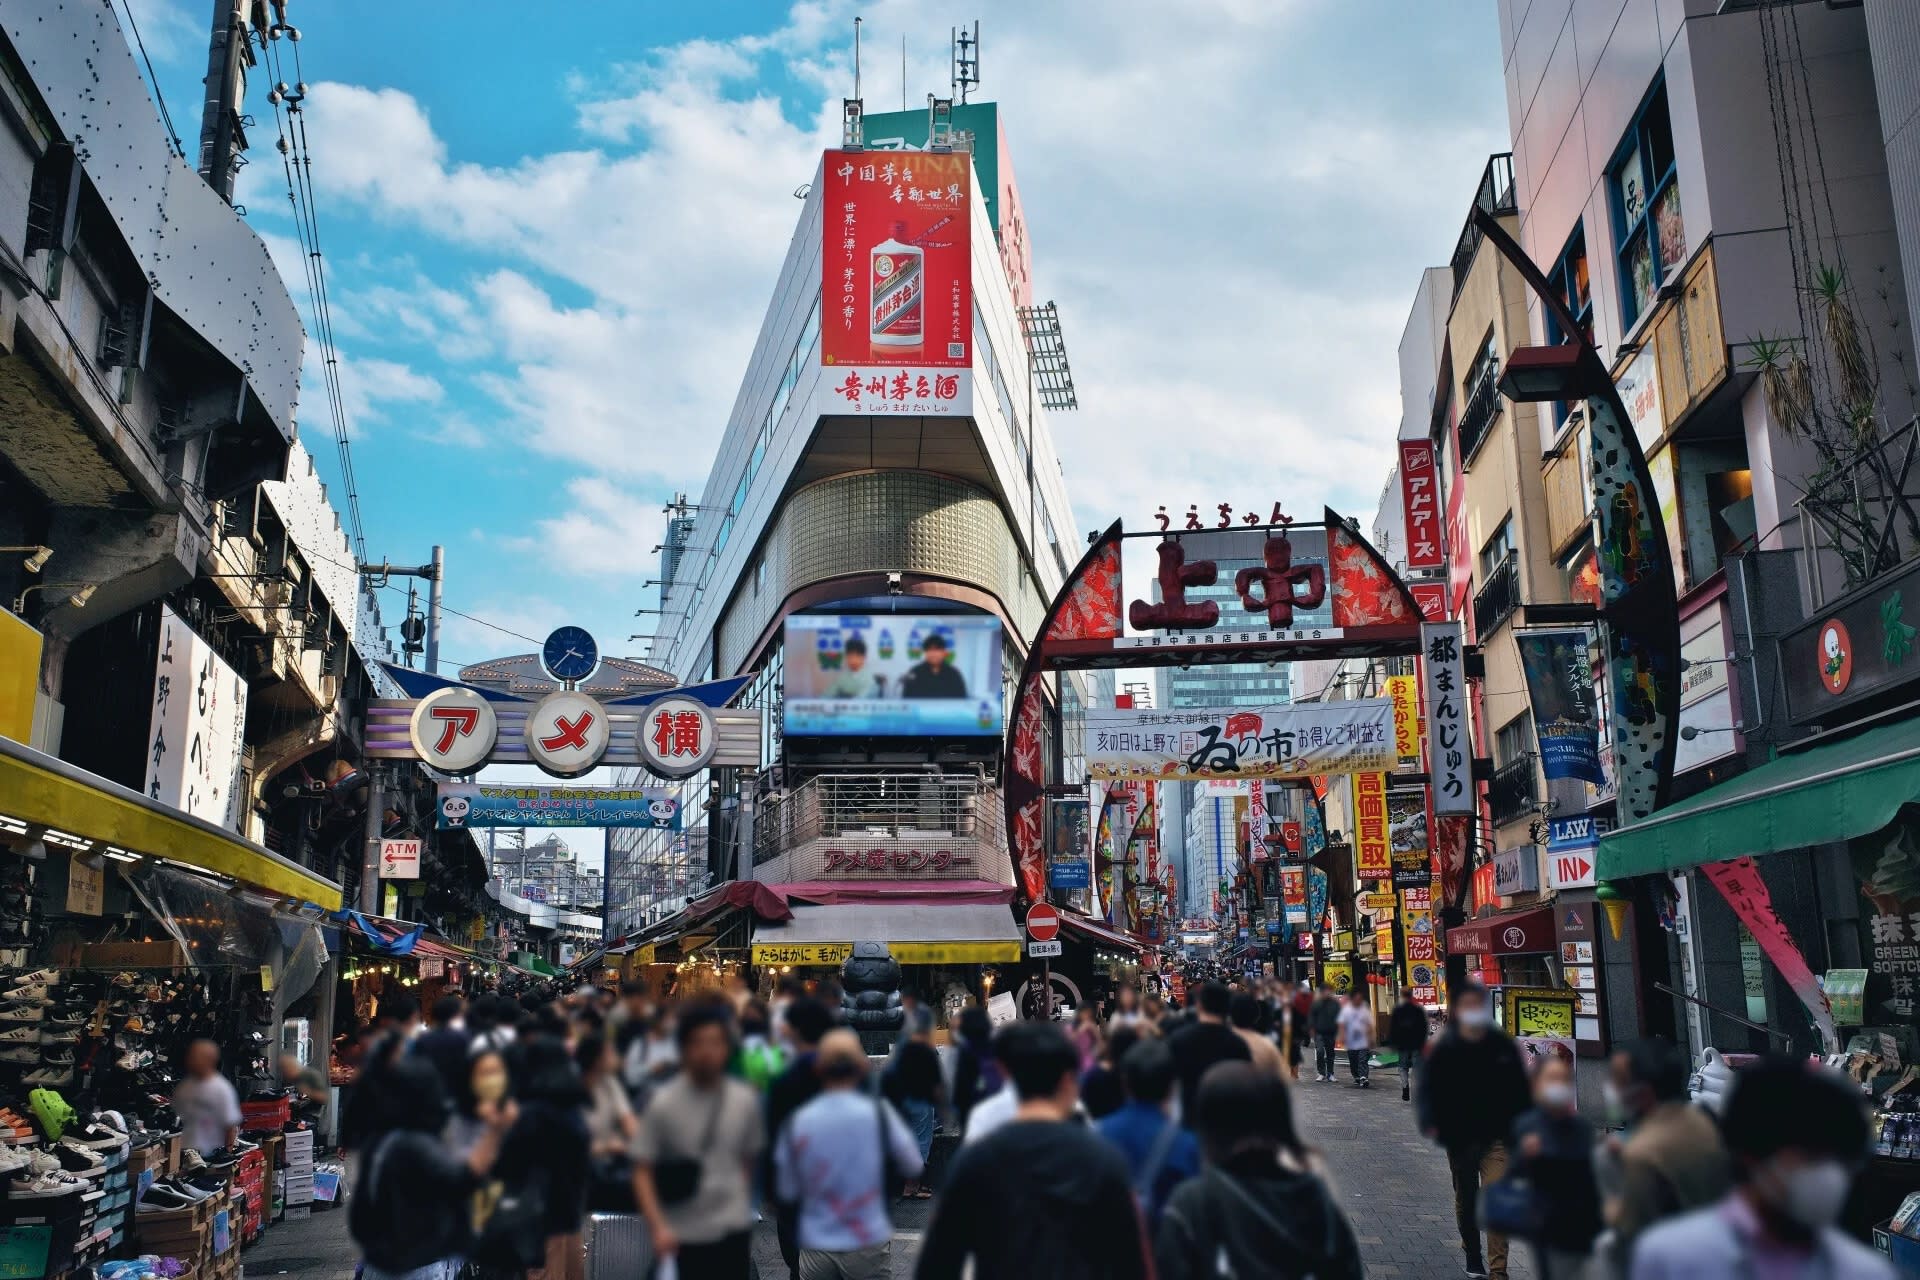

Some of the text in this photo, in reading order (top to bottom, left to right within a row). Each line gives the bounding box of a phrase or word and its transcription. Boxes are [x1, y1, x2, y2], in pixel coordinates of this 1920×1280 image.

[842, 202, 857, 331] 世界に漂う 茅台の香り
[1408, 476, 1434, 558] アドアーズ
[1129, 537, 1326, 631] 上中
[1134, 629, 1322, 647] 上野中通商店街振興組合
[1391, 679, 1411, 755] おたからや
[1429, 635, 1462, 798] 都まんじゅう
[431, 707, 704, 759] アメ横
[1097, 731, 1178, 752] 亥の日は上野で
[1298, 722, 1386, 749] お得とご利益を
[1357, 772, 1387, 867] 高価買取
[384, 842, 417, 855] ATM
[823, 849, 972, 872] アメ横センター
[1557, 856, 1578, 883] IN
[1359, 869, 1390, 878] おたからや
[1405, 888, 1417, 900] 金
[1408, 936, 1433, 948] ブランド
[1409, 947, 1433, 959] バッグ
[1412, 987, 1435, 1000] 切手
[1521, 1003, 1563, 1021] 串かつ
